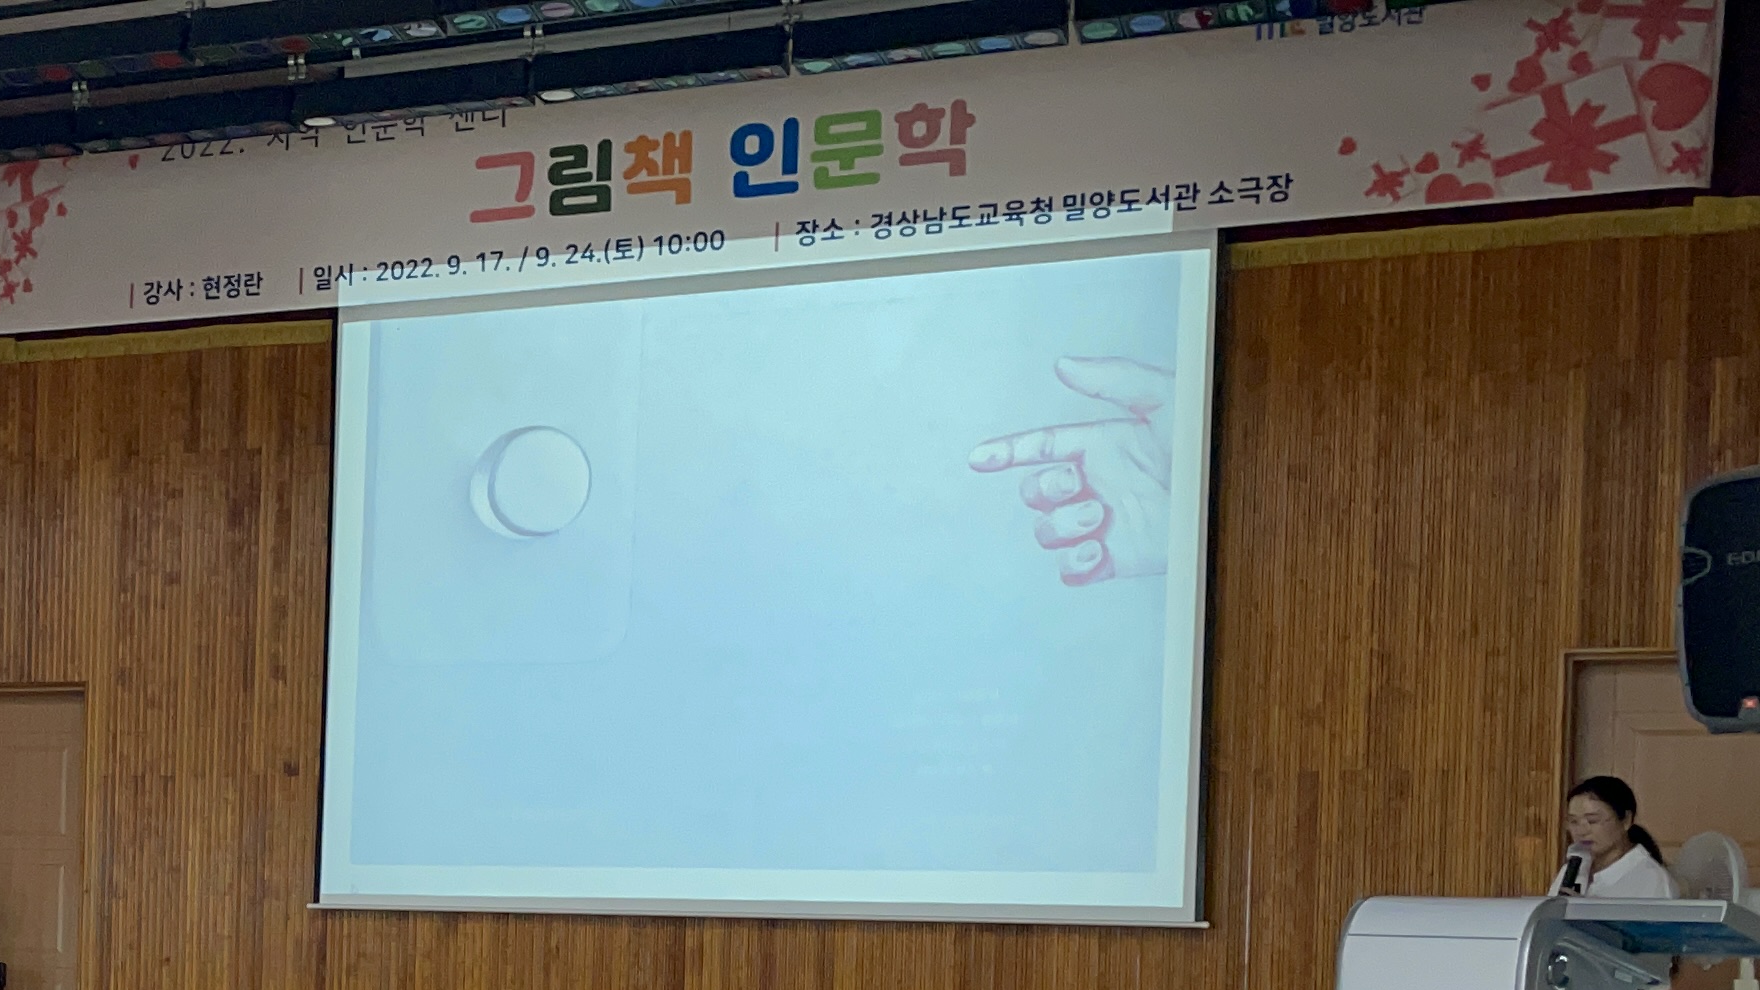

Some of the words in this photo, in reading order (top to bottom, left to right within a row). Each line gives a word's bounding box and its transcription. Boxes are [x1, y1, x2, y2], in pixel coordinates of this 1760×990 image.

[469, 129, 694, 224] 그림책
[729, 98, 977, 200] 인문학
[794, 218, 845, 247] 장소
[870, 195, 1055, 241] 경상남도교육청
[1062, 181, 1201, 222] 밀양도서관
[1207, 172, 1294, 206] 소극장
[142, 279, 184, 306] 강사
[201, 271, 264, 301] 현정란
[312, 262, 354, 292] 일시
[375, 257, 440, 283] 2022.
[653, 229, 726, 257] 10:00
